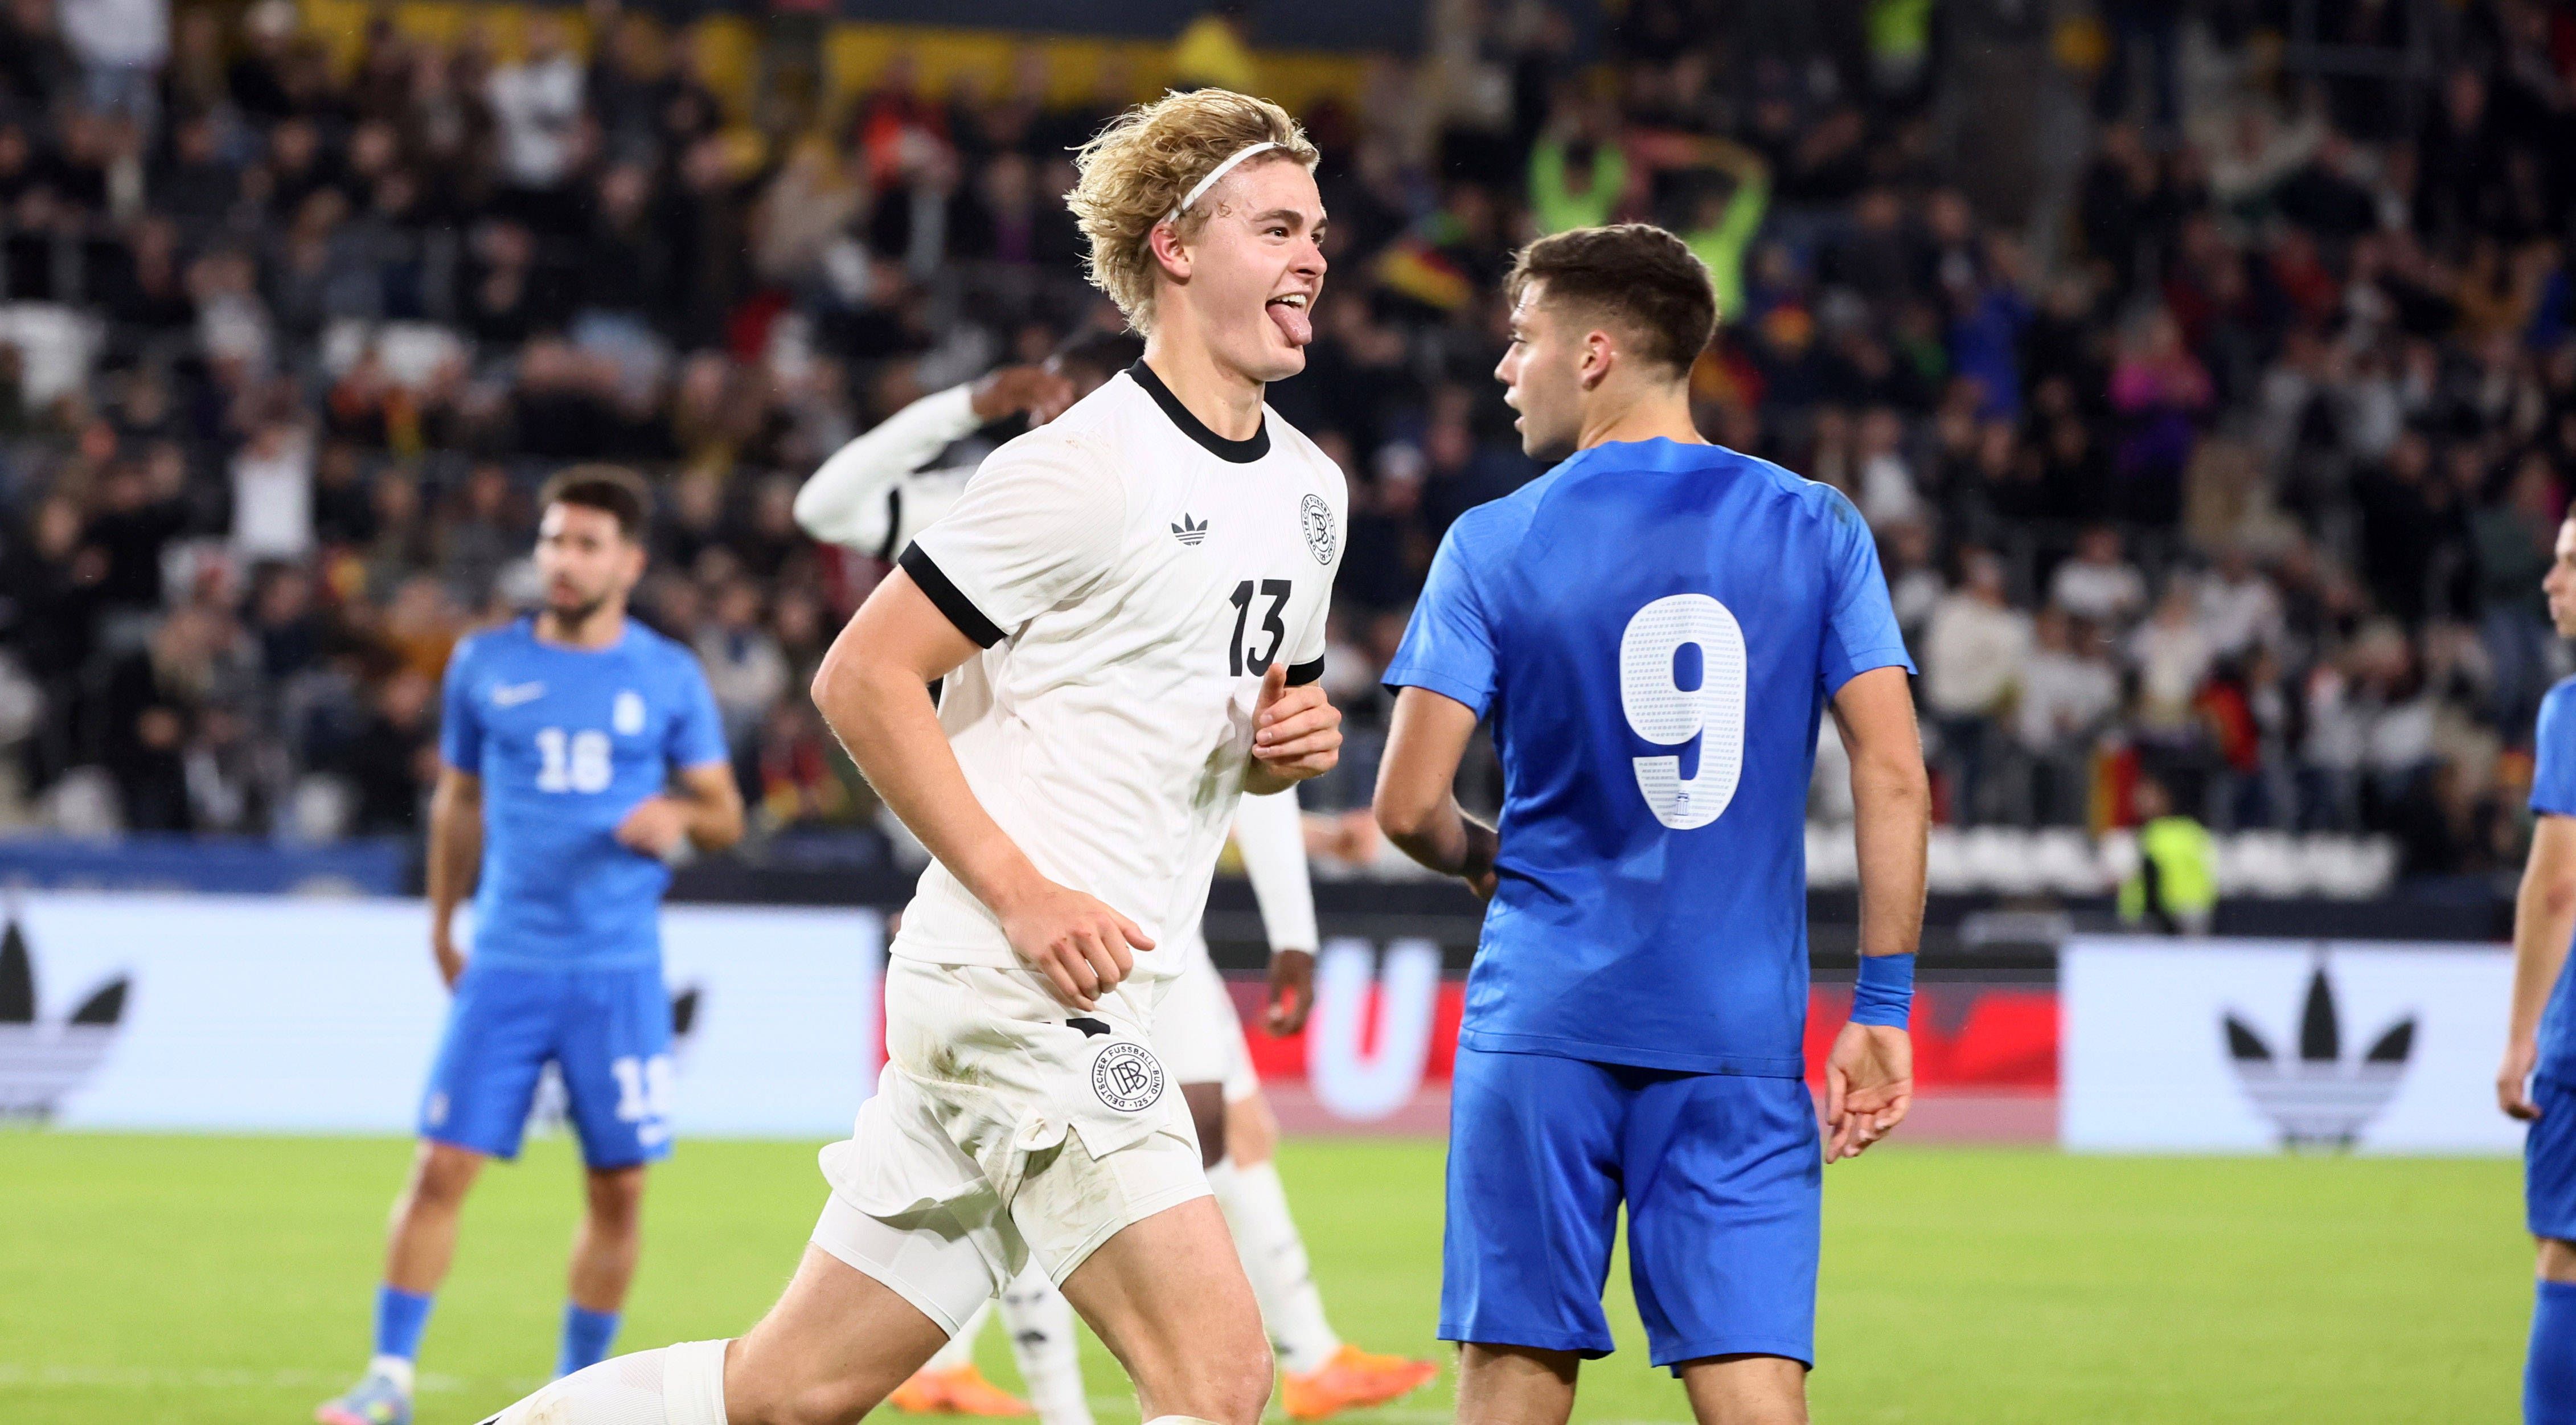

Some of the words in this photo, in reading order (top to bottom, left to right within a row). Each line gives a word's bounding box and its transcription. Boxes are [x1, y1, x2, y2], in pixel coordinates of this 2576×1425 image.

[1229, 579, 1292, 677] 13
[1619, 593, 1748, 830] 9
[1310, 940, 1439, 1118] U
[1096, 1057, 1125, 1107] DEUTSCHER
[1108, 1046, 1160, 1095] FUSSBALL-BUND
[1134, 1098, 1149, 1108] 125
